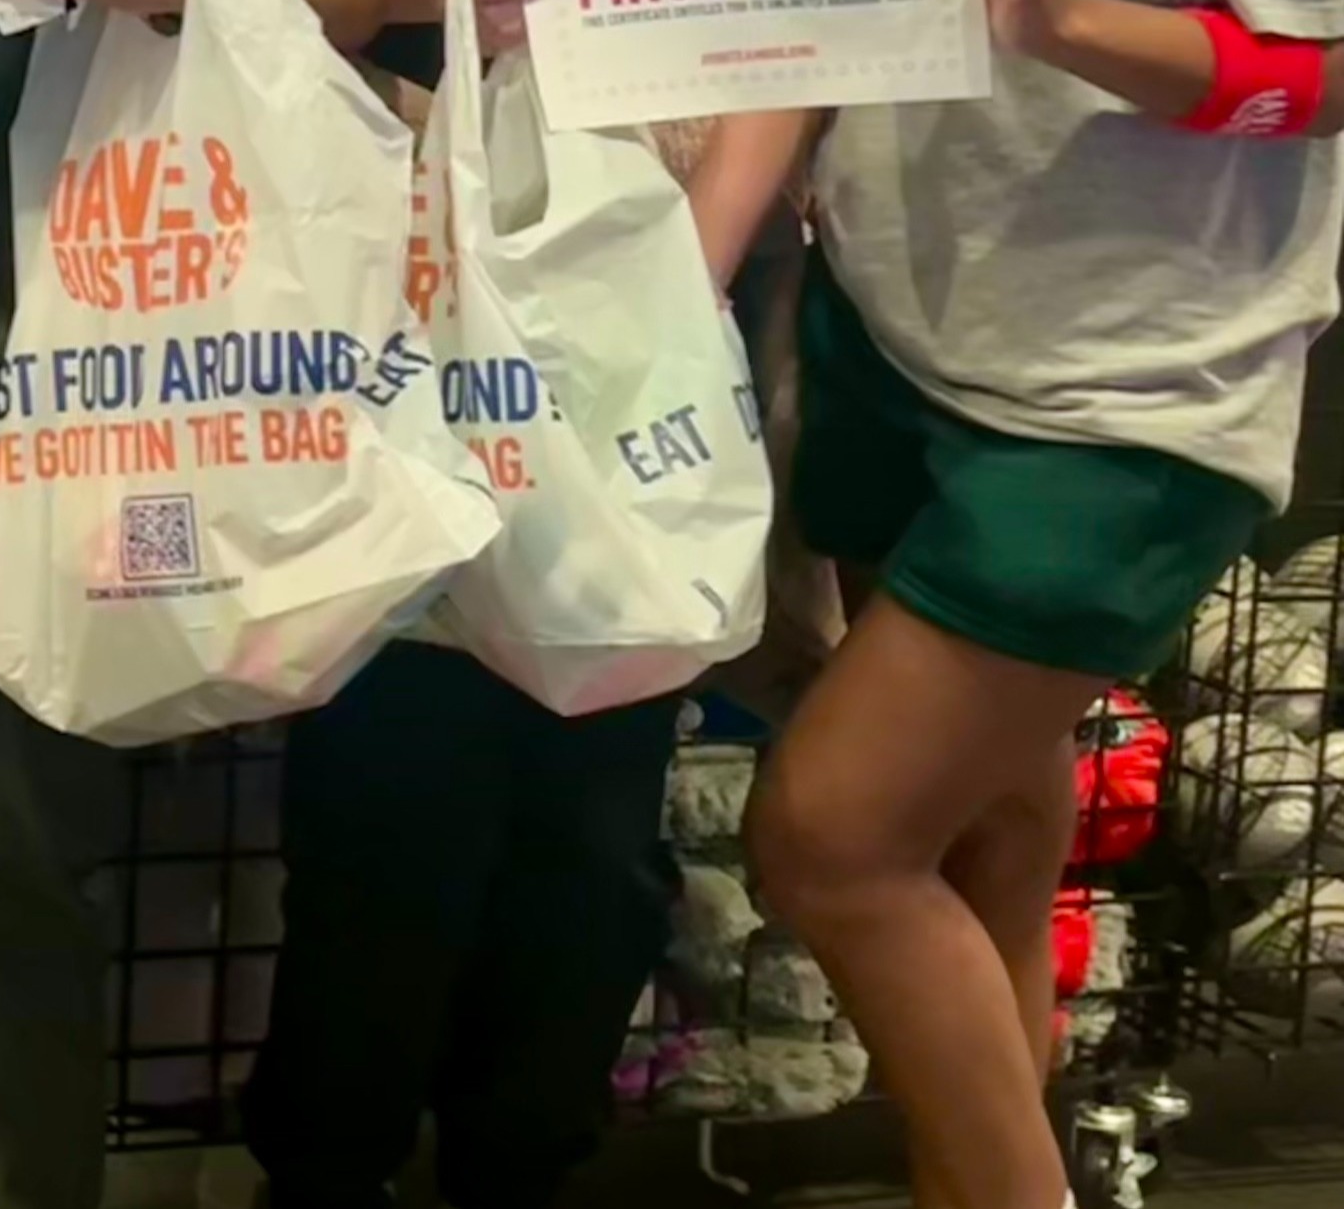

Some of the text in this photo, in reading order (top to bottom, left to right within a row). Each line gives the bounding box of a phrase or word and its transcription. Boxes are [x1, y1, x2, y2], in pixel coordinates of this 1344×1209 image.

[49, 134, 247, 242] DAVE &
[53, 229, 247, 313] BUSTER'S
[615, 403, 712, 485] EAT
